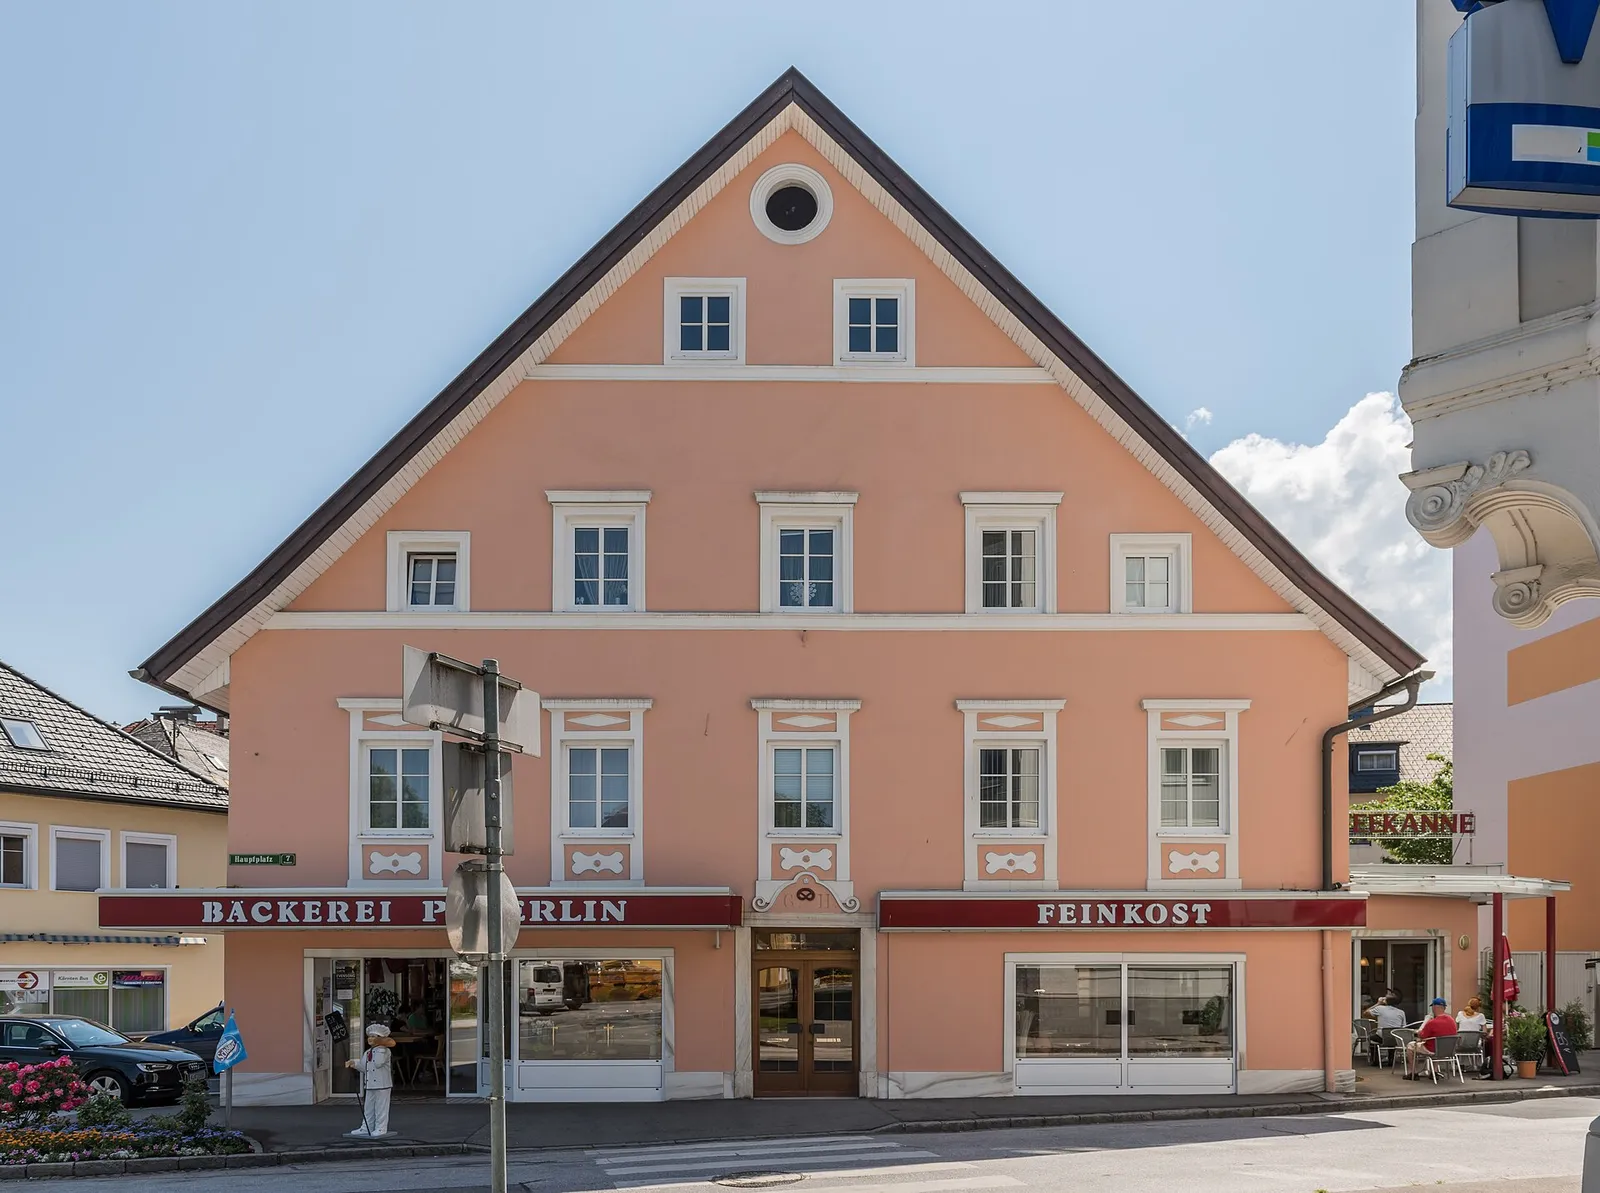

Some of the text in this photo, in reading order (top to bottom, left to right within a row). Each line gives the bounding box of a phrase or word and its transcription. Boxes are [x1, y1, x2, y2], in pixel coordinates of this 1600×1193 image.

[1352, 812, 1474, 833] EEKANNE
[202, 900, 627, 922] BÄCKEREI PRLIN
[1037, 903, 1211, 924] FEINKOST
